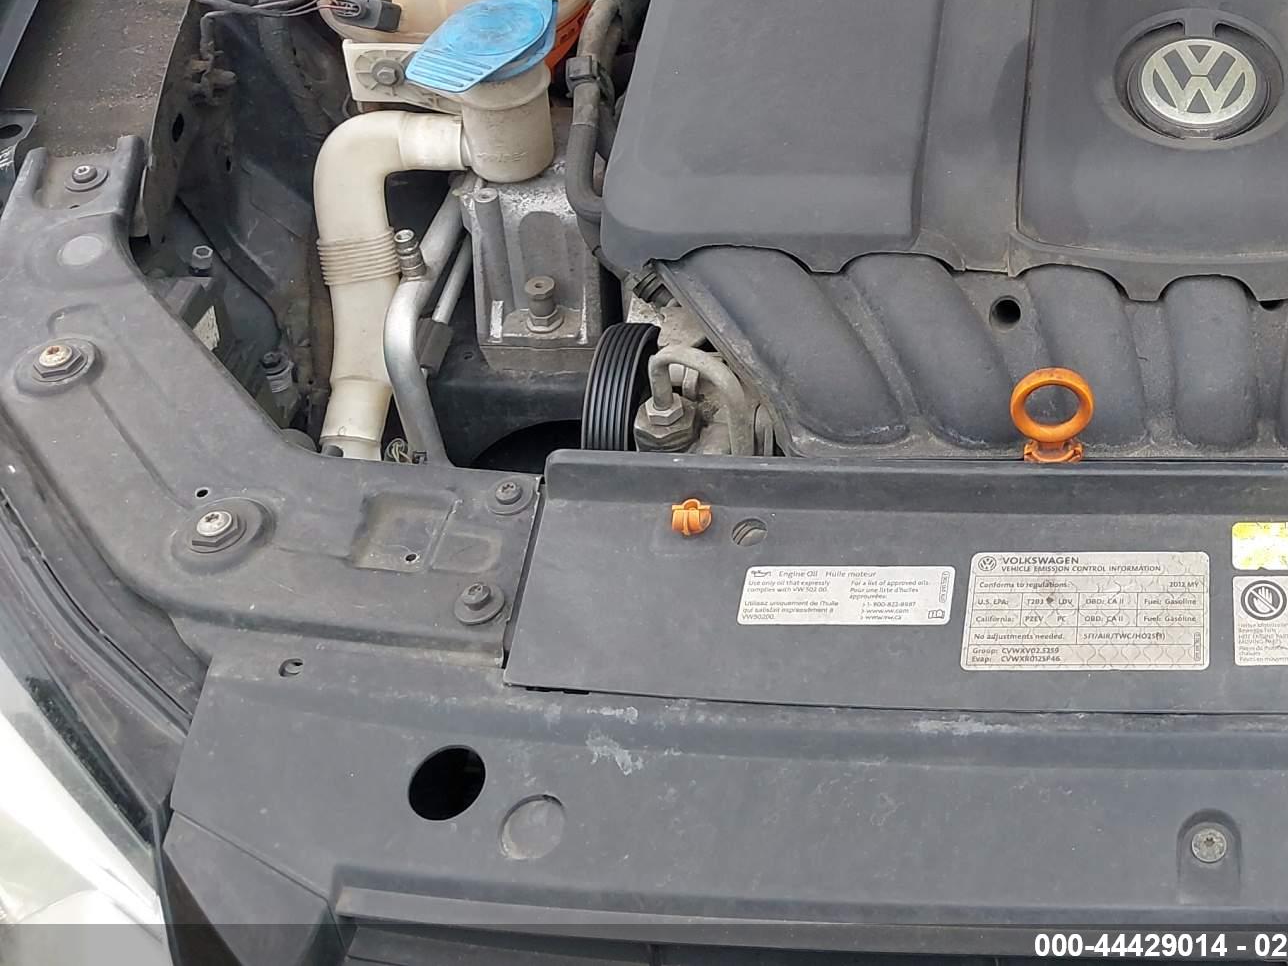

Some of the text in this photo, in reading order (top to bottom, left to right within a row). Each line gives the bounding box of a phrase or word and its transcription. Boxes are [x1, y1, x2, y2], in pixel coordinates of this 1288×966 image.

[1002, 556, 1079, 564] VOLKSWAGEN
[778, 570, 877, 578] Engine Oil Huile moteur
[974, 633, 985, 641] No
